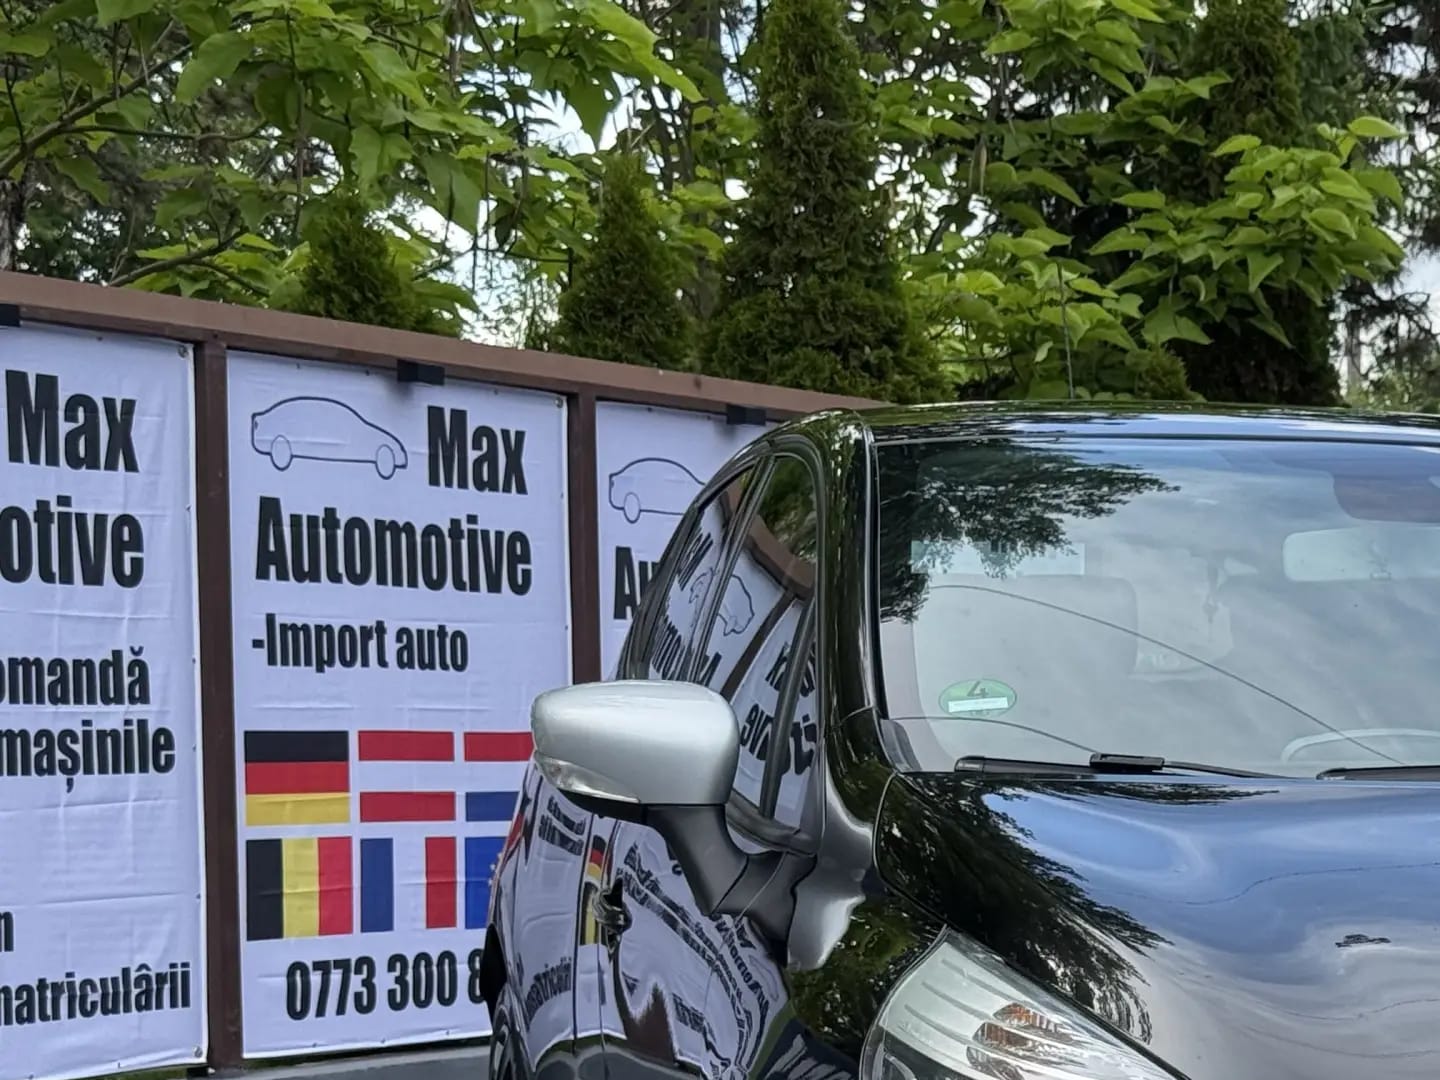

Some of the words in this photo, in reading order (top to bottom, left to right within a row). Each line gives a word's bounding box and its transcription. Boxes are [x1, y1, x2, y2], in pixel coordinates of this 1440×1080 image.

[5, 369, 140, 473] Max
[427, 405, 528, 495] Max
[255, 496, 532, 595] Automotive
[252, 613, 389, 673] -Import
[396, 625, 469, 673] auto
[285, 955, 377, 1021] 0773
[387, 950, 458, 1014] 300
